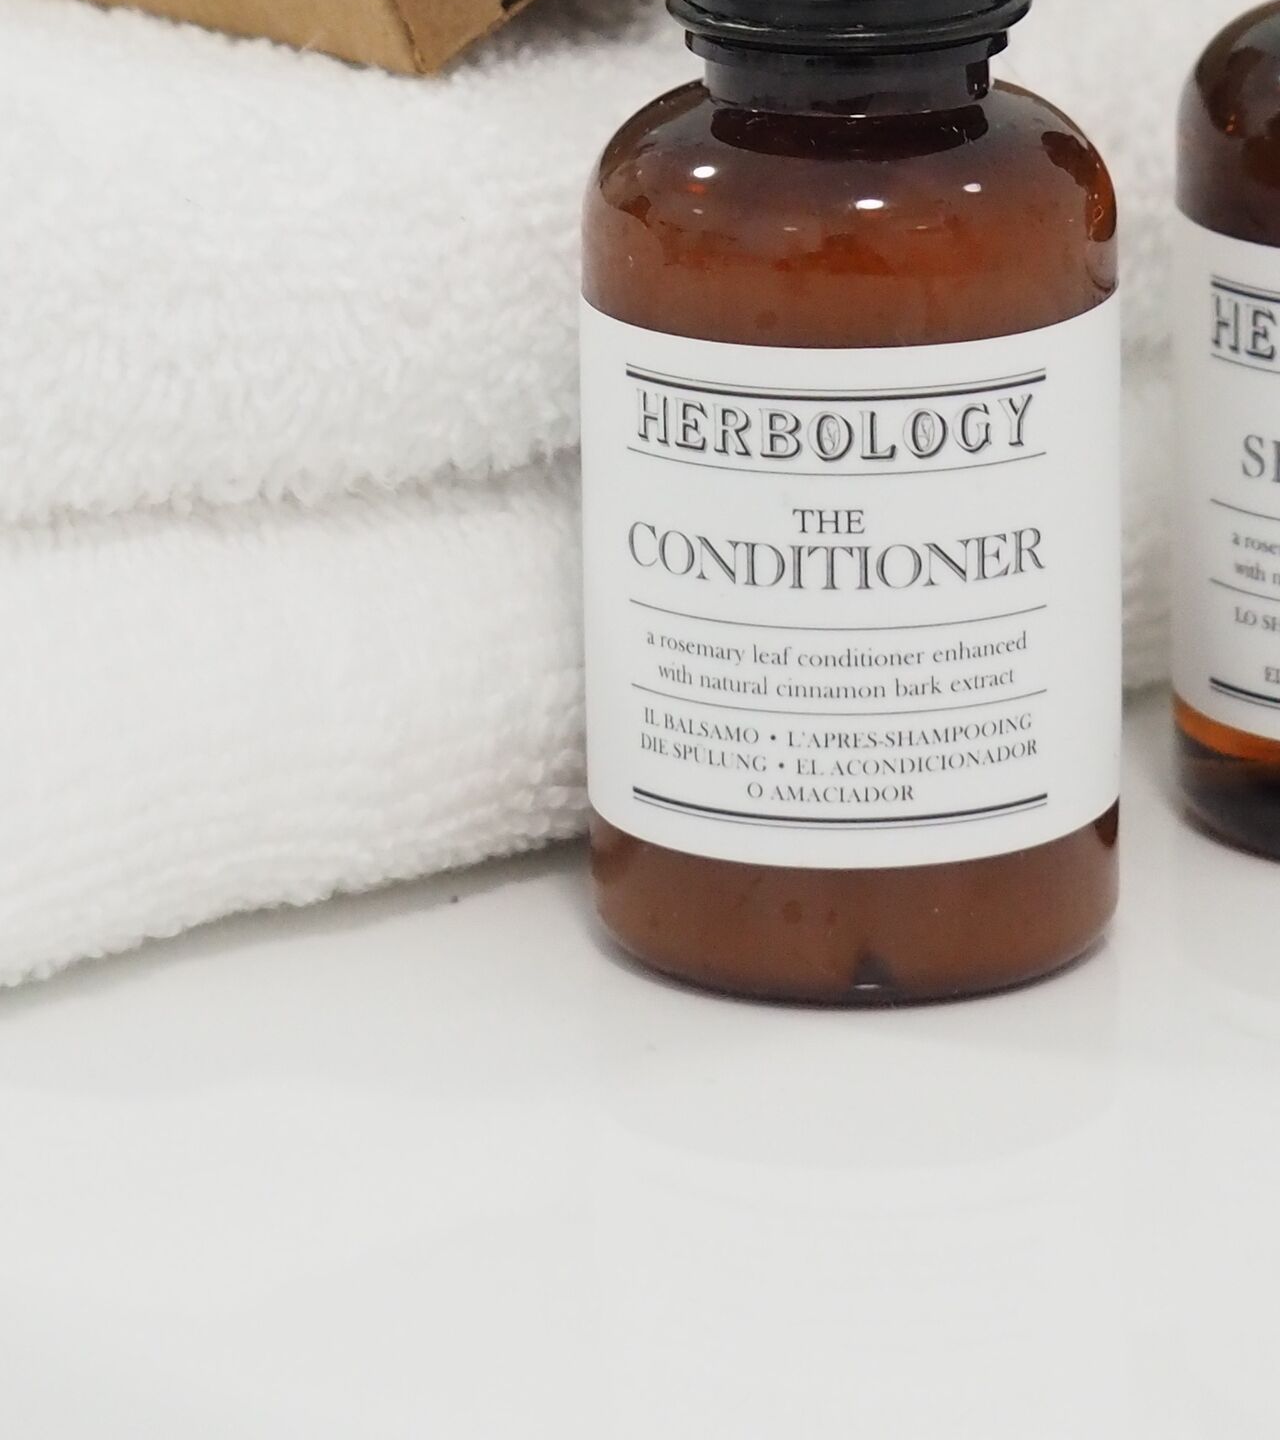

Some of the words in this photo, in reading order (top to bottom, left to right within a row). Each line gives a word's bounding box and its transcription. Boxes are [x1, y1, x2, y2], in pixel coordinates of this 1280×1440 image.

[636, 387, 1034, 462] HERBOLOGY
[792, 508, 865, 535] THE
[1232, 532, 1240, 546] a
[628, 520, 1046, 591] CONDITIONER
[1234, 561, 1265, 582] with
[1234, 606, 1257, 626] LO
[647, 632, 655, 647] a
[660, 633, 745, 665] rosemary
[753, 644, 792, 667] leaf
[798, 646, 923, 669] conditioner
[933, 631, 1028, 664] enhanced
[658, 663, 693, 687] with
[700, 670, 767, 696] natural
[776, 676, 887, 699] cinnamon
[894, 675, 942, 697] bark
[950, 667, 1015, 693] extract
[645, 707, 660, 726] IL
[664, 713, 759, 744] BALSAMO
[641, 732, 669, 756] DIE
[797, 759, 824, 776] EL
[831, 739, 1038, 777] ACONDICIONADOR
[747, 782, 763, 799] O
[771, 784, 915, 804] AMACIADOR
